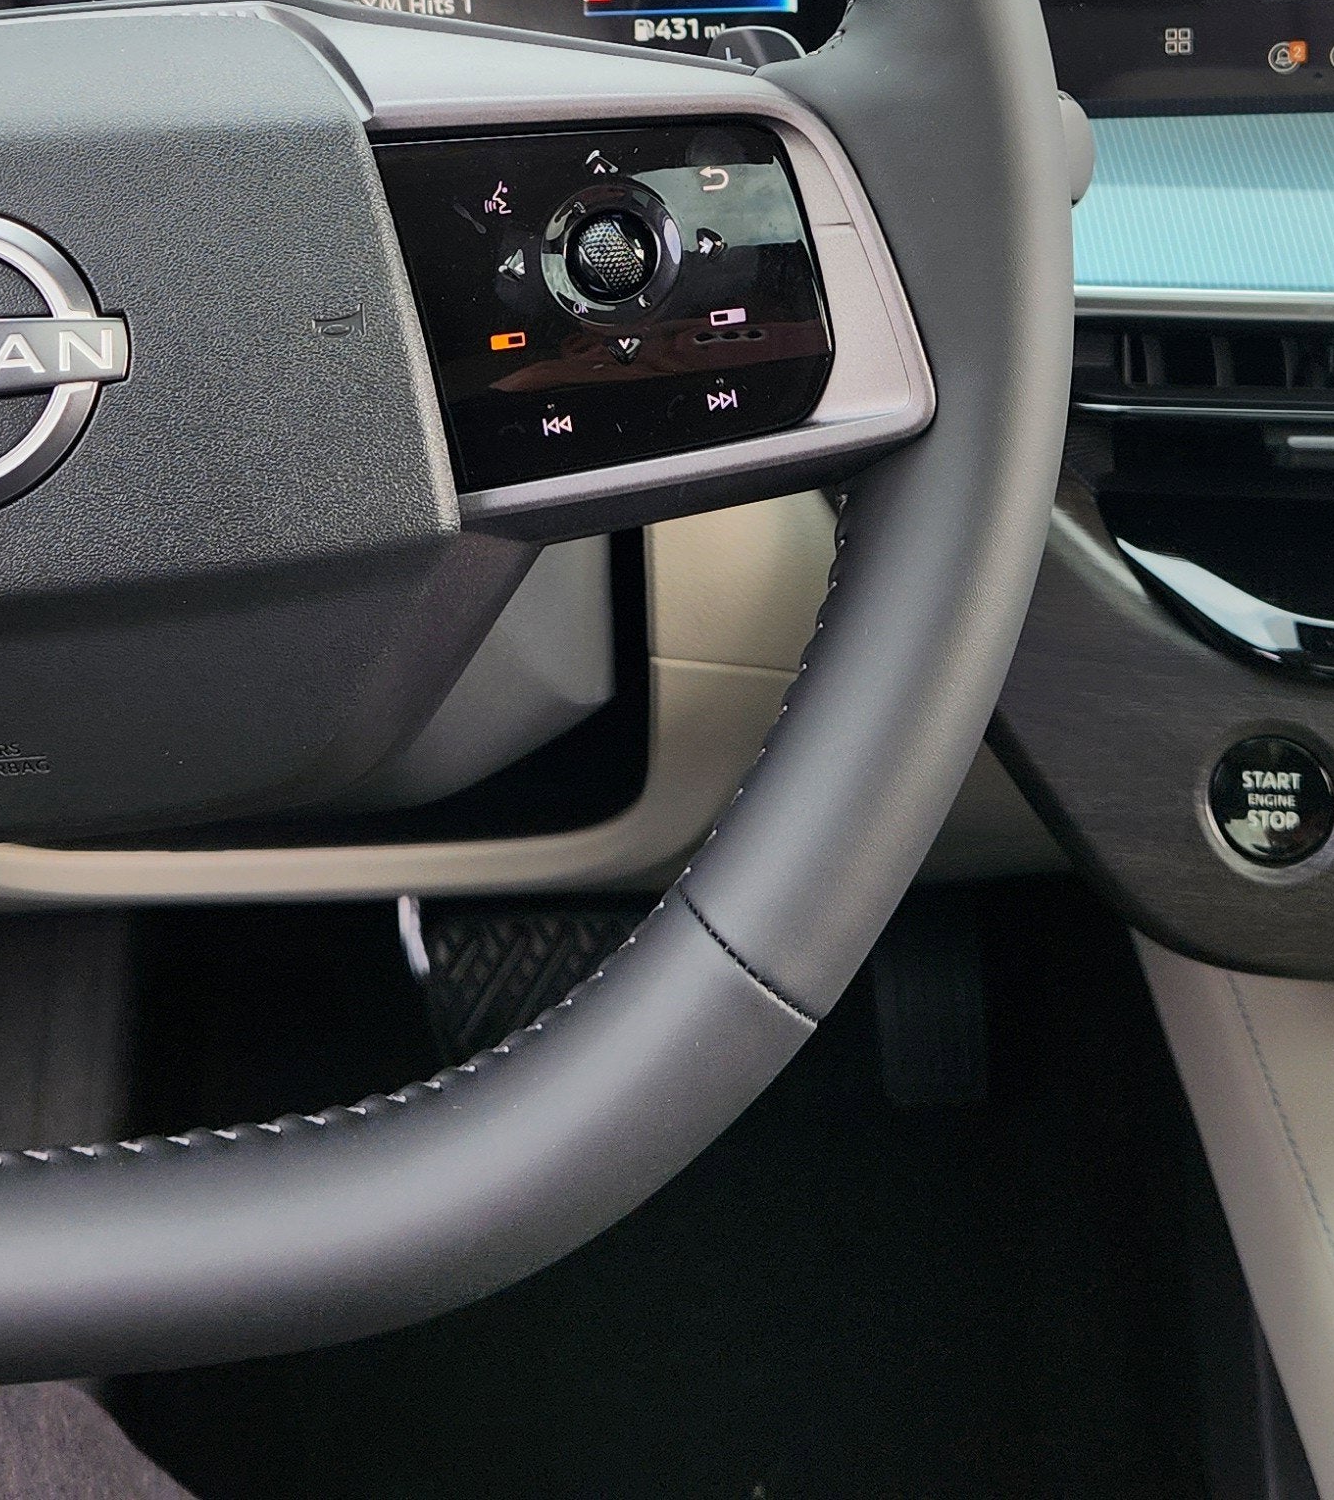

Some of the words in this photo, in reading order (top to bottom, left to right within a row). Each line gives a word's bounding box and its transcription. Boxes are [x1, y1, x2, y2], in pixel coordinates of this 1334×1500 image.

[655, 18, 699, 40] 431
[1294, 46, 1302, 59] 2
[572, 302, 589, 314] OK
[1242, 770, 1302, 790] START
[1247, 793, 1297, 808] ENGINE
[1247, 809, 1301, 832] STOP
